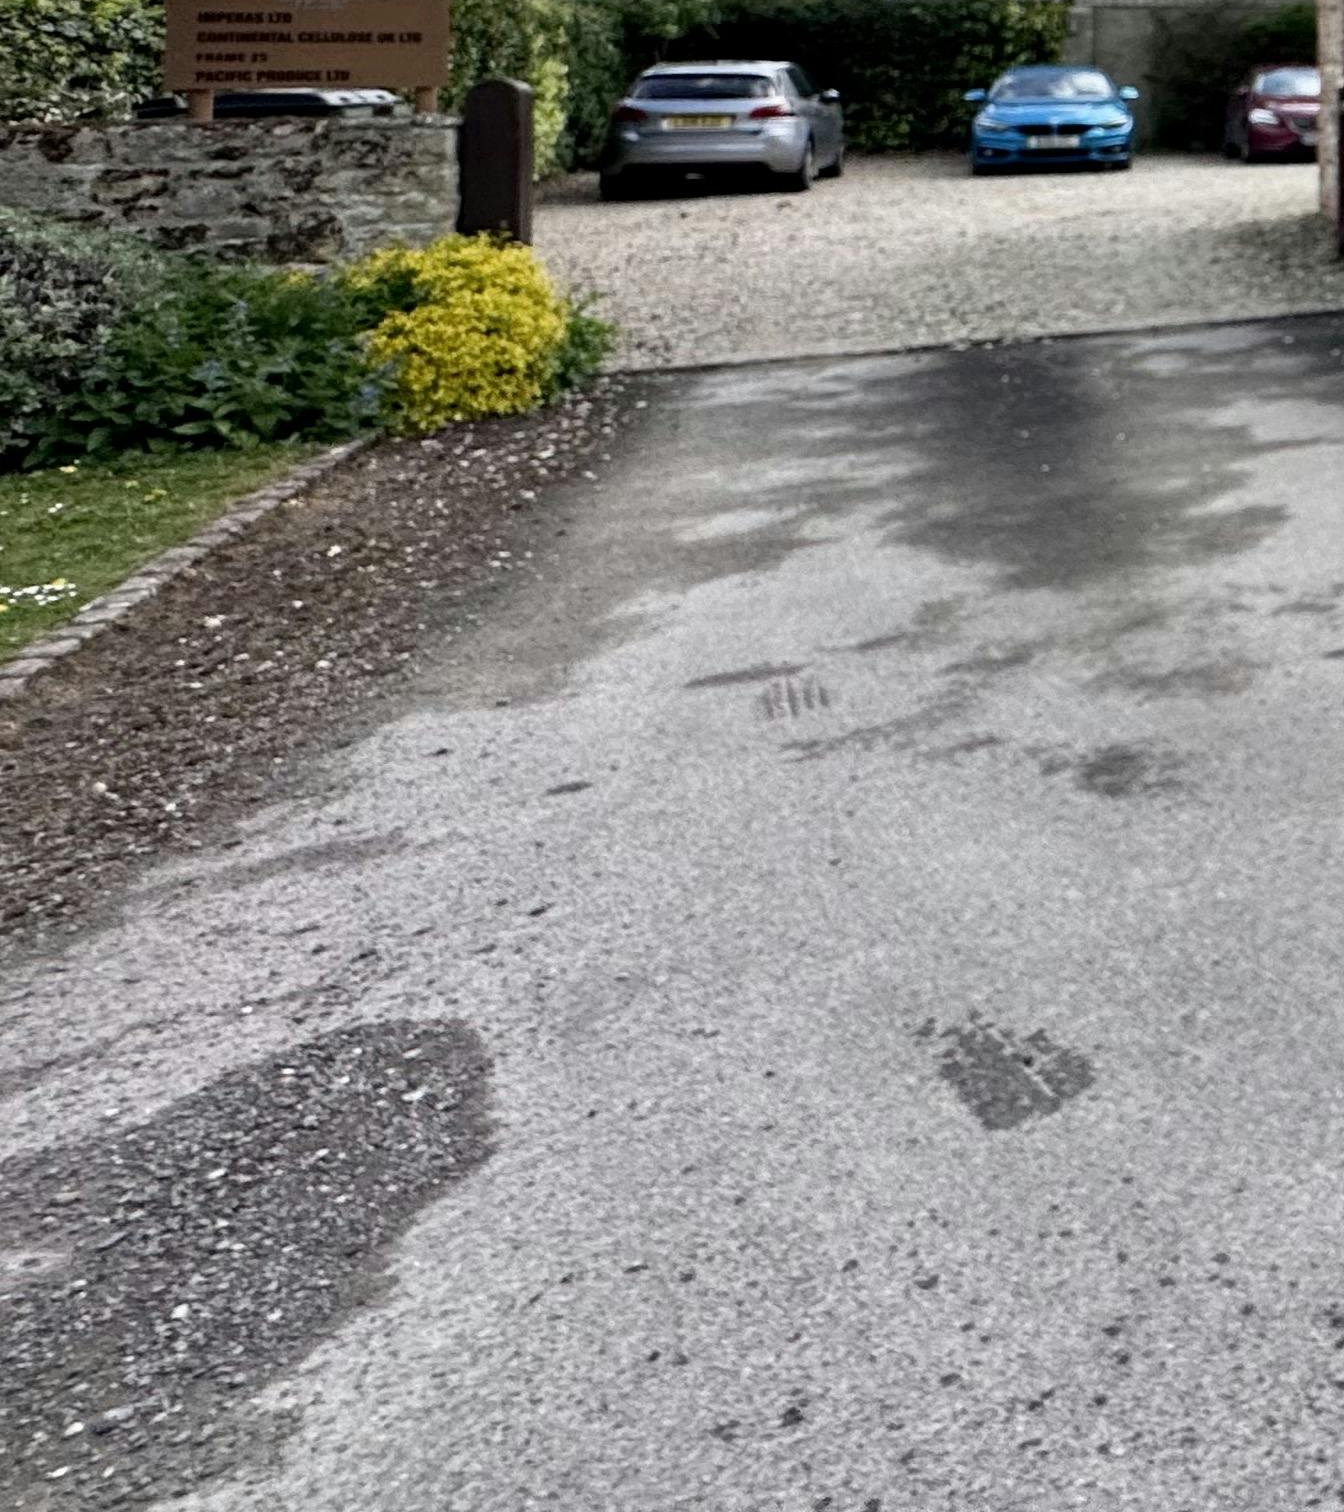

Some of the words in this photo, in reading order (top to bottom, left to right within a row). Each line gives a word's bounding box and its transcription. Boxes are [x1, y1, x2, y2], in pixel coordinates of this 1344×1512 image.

[268, 11, 292, 24] LTD
[399, 31, 423, 44] LTD
[195, 70, 253, 82] PACIFIC
[326, 70, 350, 81] LTD
